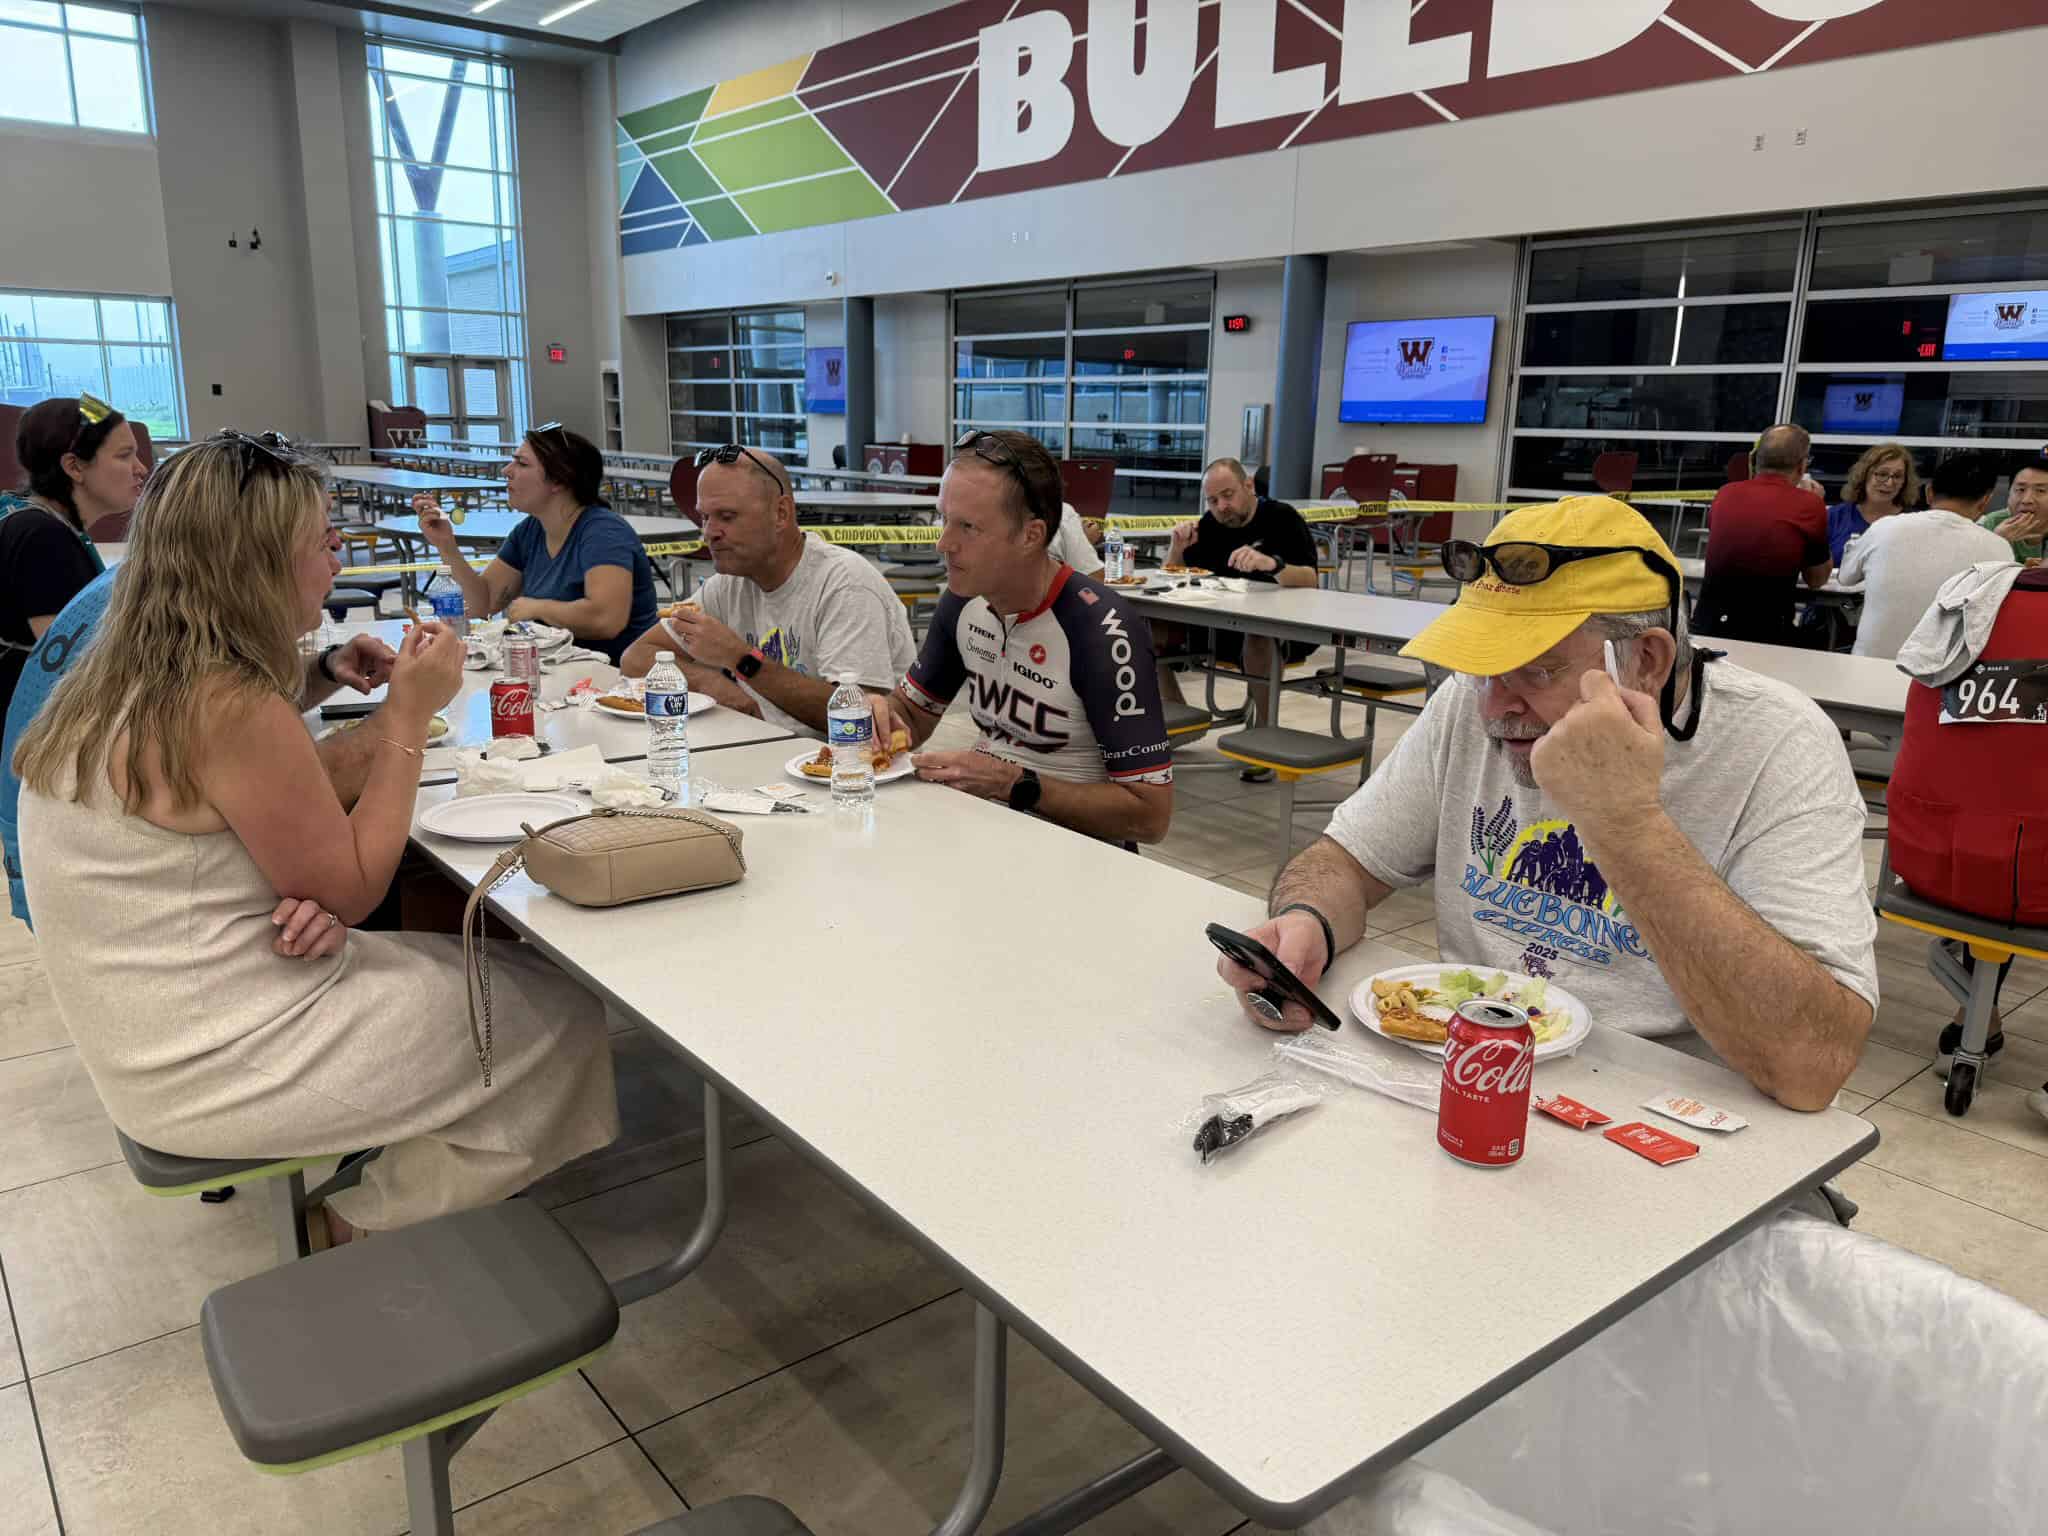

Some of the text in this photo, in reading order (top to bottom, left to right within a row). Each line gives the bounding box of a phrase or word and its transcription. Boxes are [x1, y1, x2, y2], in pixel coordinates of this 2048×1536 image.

[977, 0, 1888, 173] BULL
[1399, 338, 1435, 367] W
[967, 623, 996, 641] TREK
[1958, 678, 2020, 715] 964
[1460, 863, 1656, 962] BLUEBONNE
[1525, 942, 1559, 961] 2025
